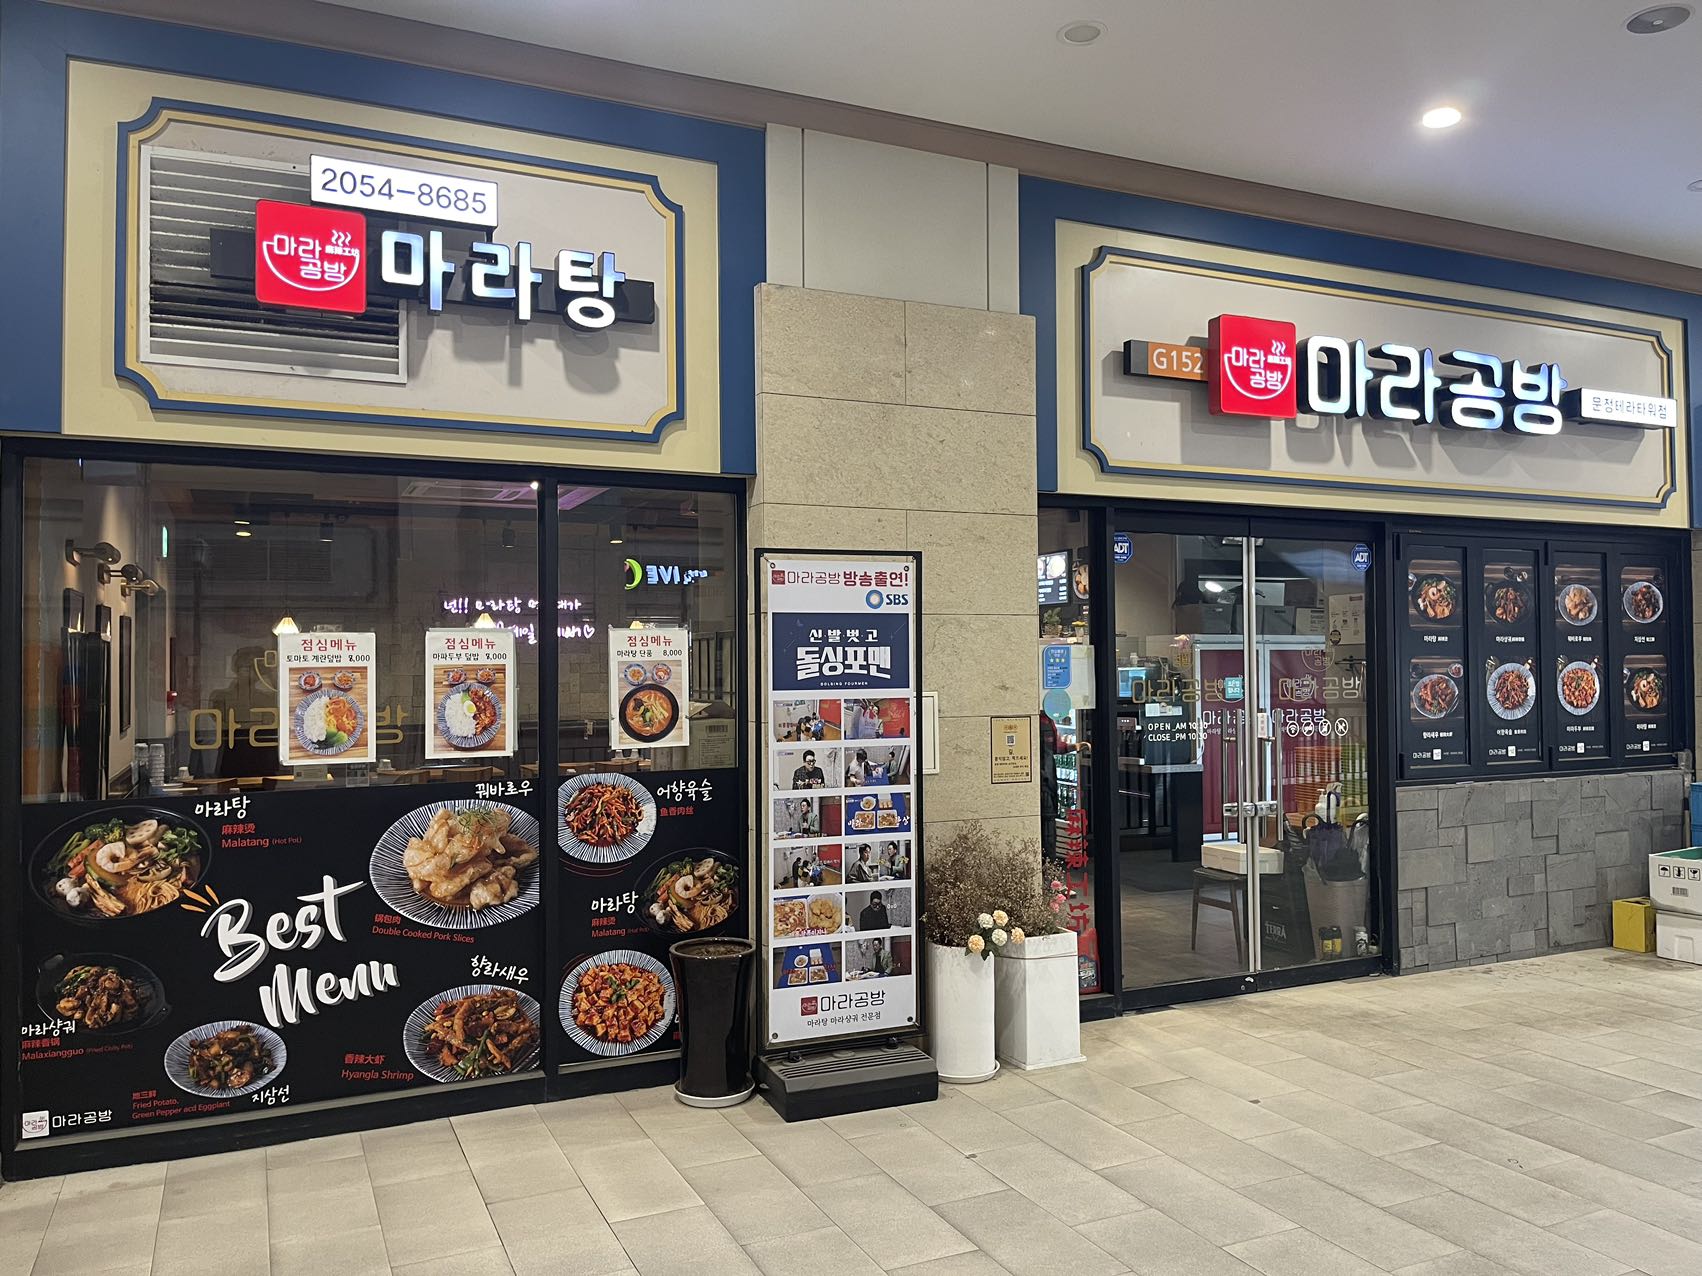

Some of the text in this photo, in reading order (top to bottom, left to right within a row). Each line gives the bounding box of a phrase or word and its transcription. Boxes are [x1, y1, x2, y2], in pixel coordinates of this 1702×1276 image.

[321, 168, 487, 214] 2054-8685
[273, 234, 322, 259] 마라
[300, 258, 347, 283] 공방
[382, 230, 626, 328] 마라탕
[1153, 348, 1203, 374] G152
[1231, 346, 1265, 369] 마라
[1250, 369, 1283, 390] 공방
[1306, 334, 1568, 435] 마라공방
[1592, 396, 1667, 420] 문정테라타워점
[1355, 552, 1369, 562] ADT
[787, 571, 840, 585] 마라공방
[843, 571, 909, 587] 방송출연!
[475, 597, 522, 614] 마라탕
[886, 594, 909, 606] SBS
[301, 639, 357, 652] 점심메뉴
[445, 638, 497, 650] 점심메뉴
[627, 636, 673, 648] 점심메뉴
[286, 655, 309, 663] 토마토
[433, 653, 463, 661] 마파두부
[662, 649, 683, 657] 8,000
[796, 646, 891, 681] 돌싱포맨
[1148, 722, 1171, 731] OPEN
[1148, 733, 1171, 742] CLOSE
[475, 780, 533, 799] 꿔바로우
[657, 778, 713, 801] 어향육슬
[194, 795, 251, 819] 마라탕
[221, 837, 269, 849] Malatang
[591, 891, 639, 914] 마라탕
[201, 875, 367, 982] Best
[372, 926, 475, 944] Double Cooked Pork Slices
[592, 928, 626, 938] Malatang
[471, 955, 529, 984] 향라새우
[259, 960, 400, 1028] Menu
[820, 990, 886, 1012] 마라공방
[21, 1018, 76, 1037] 마라샹궈
[807, 1018, 828, 1027] 마라탕
[860, 1011, 881, 1022] 전문점
[22, 1048, 84, 1060] Malaxiangguo
[341, 1070, 414, 1081] Hyangla Shrimp
[251, 1085, 290, 1105] 지삼선
[132, 1101, 152, 1109] Fried
[132, 1111, 155, 1120] Green
[156, 1108, 183, 1118] Pepper
[198, 1100, 231, 1112] Eggplant
[52, 1110, 112, 1128] 마라공방
